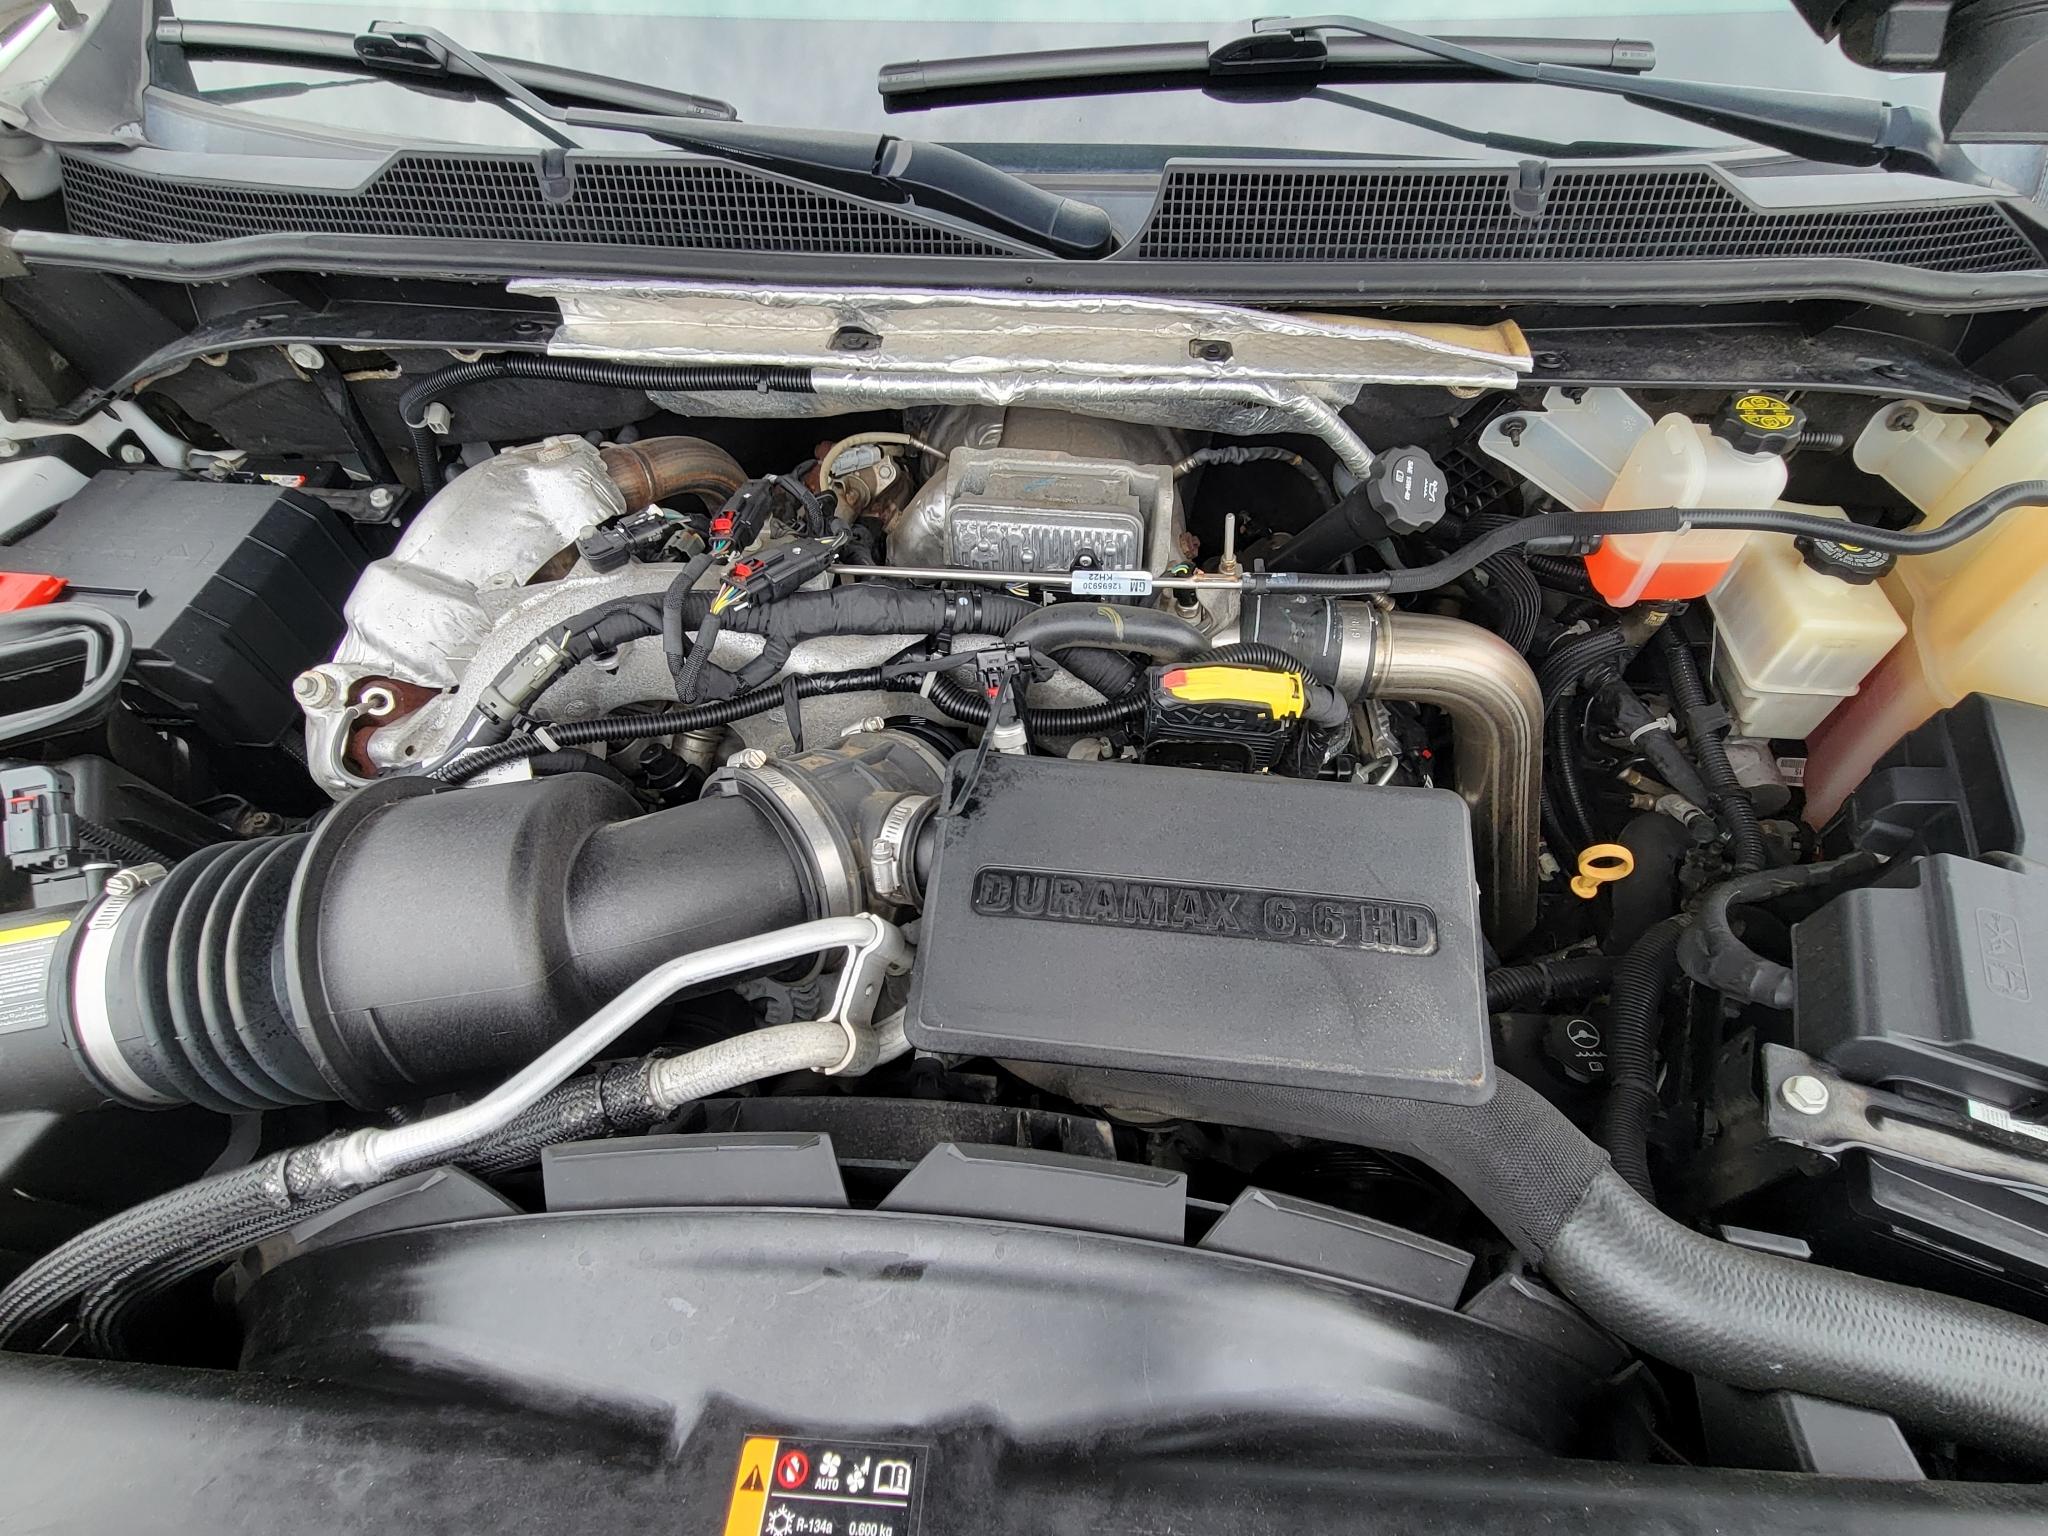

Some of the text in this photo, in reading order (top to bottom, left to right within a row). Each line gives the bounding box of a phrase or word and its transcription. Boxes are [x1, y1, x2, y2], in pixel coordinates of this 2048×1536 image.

[1083, 581, 1146, 592] GM 12695930
[979, 872, 1431, 949] DURAMAX 6.6 HD
[815, 1478, 839, 1491] AUTO
[796, 1517, 893, 1536] R-134a 0.600 kg
